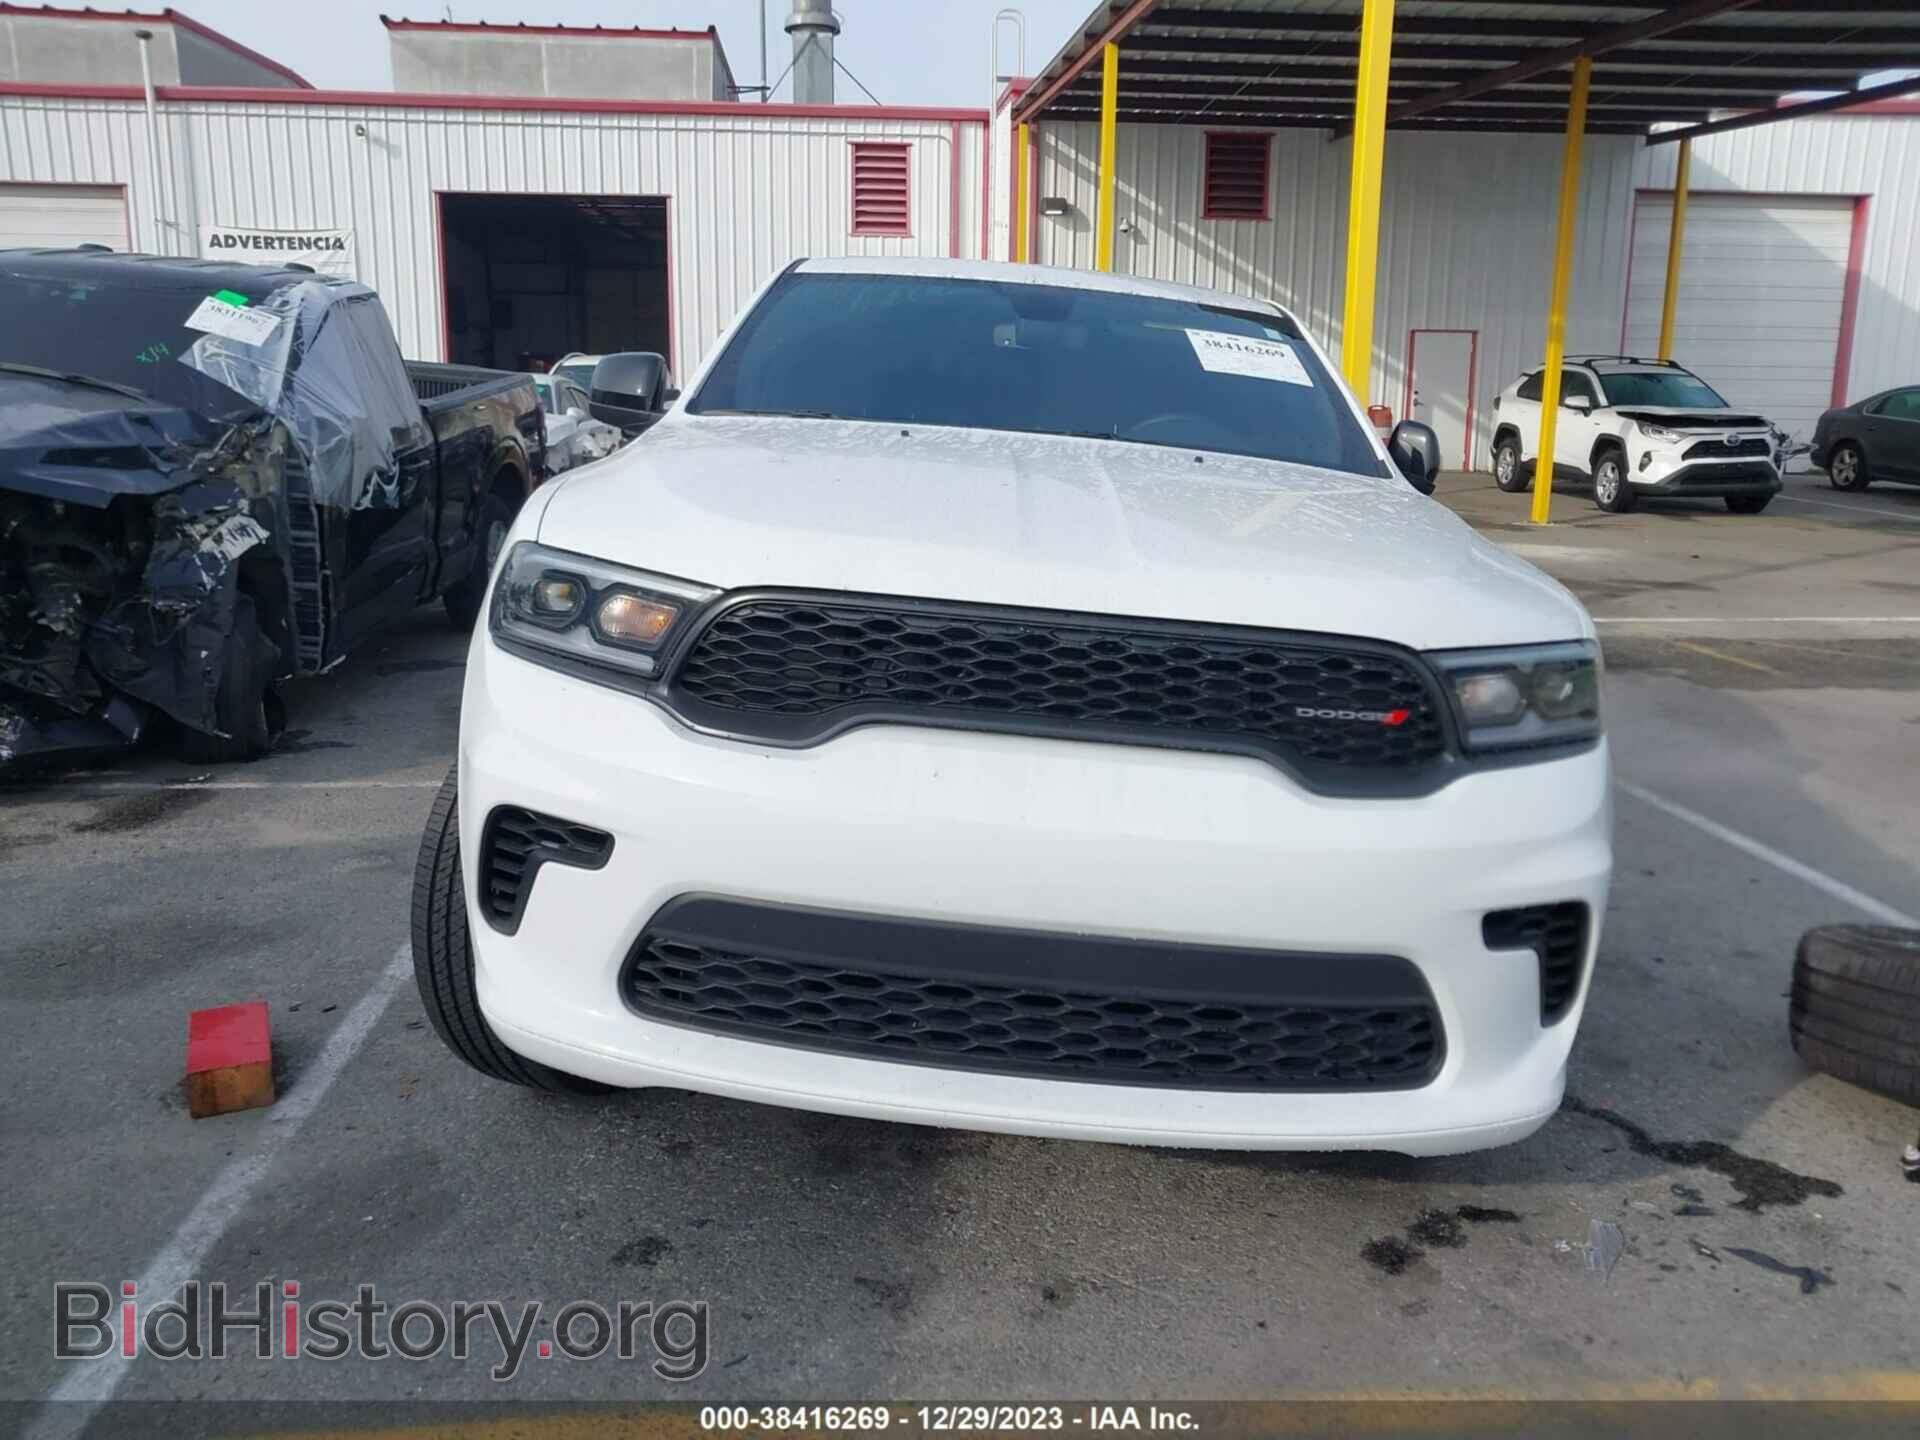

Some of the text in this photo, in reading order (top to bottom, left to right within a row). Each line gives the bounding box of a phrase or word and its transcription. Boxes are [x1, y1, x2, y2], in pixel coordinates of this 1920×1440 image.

[209, 234, 345, 250] ADVERTENCIA
[1202, 338, 1285, 358] 38416269
[1296, 707, 1387, 722] DODGE
